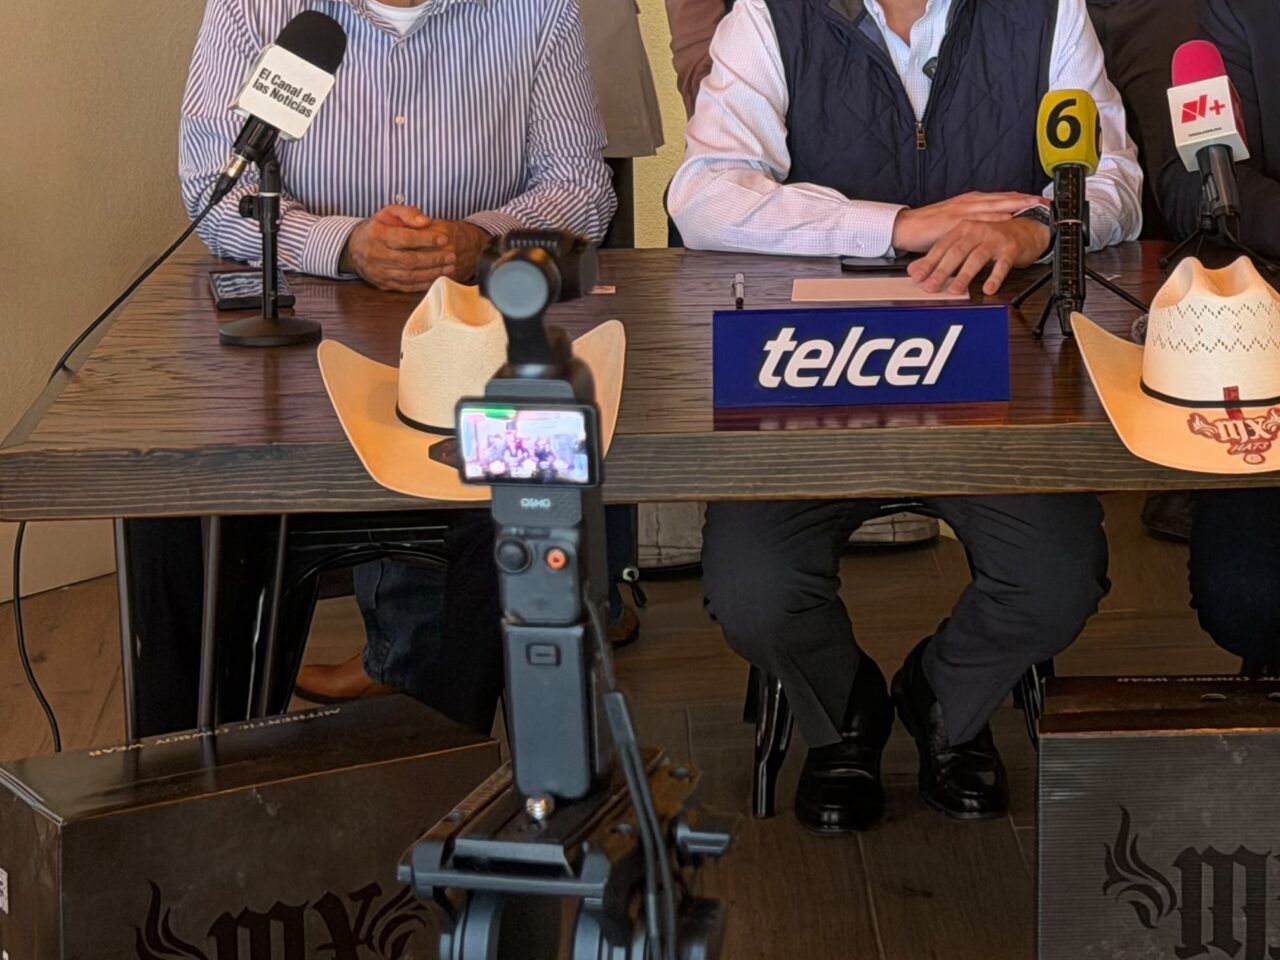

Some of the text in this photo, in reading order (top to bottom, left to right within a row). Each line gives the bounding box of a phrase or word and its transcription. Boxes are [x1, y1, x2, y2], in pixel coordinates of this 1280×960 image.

[252, 78, 313, 118] las Noticias
[258, 67, 317, 106] El Canal de
[1046, 98, 1081, 149] 6
[758, 324, 963, 388] telcel
